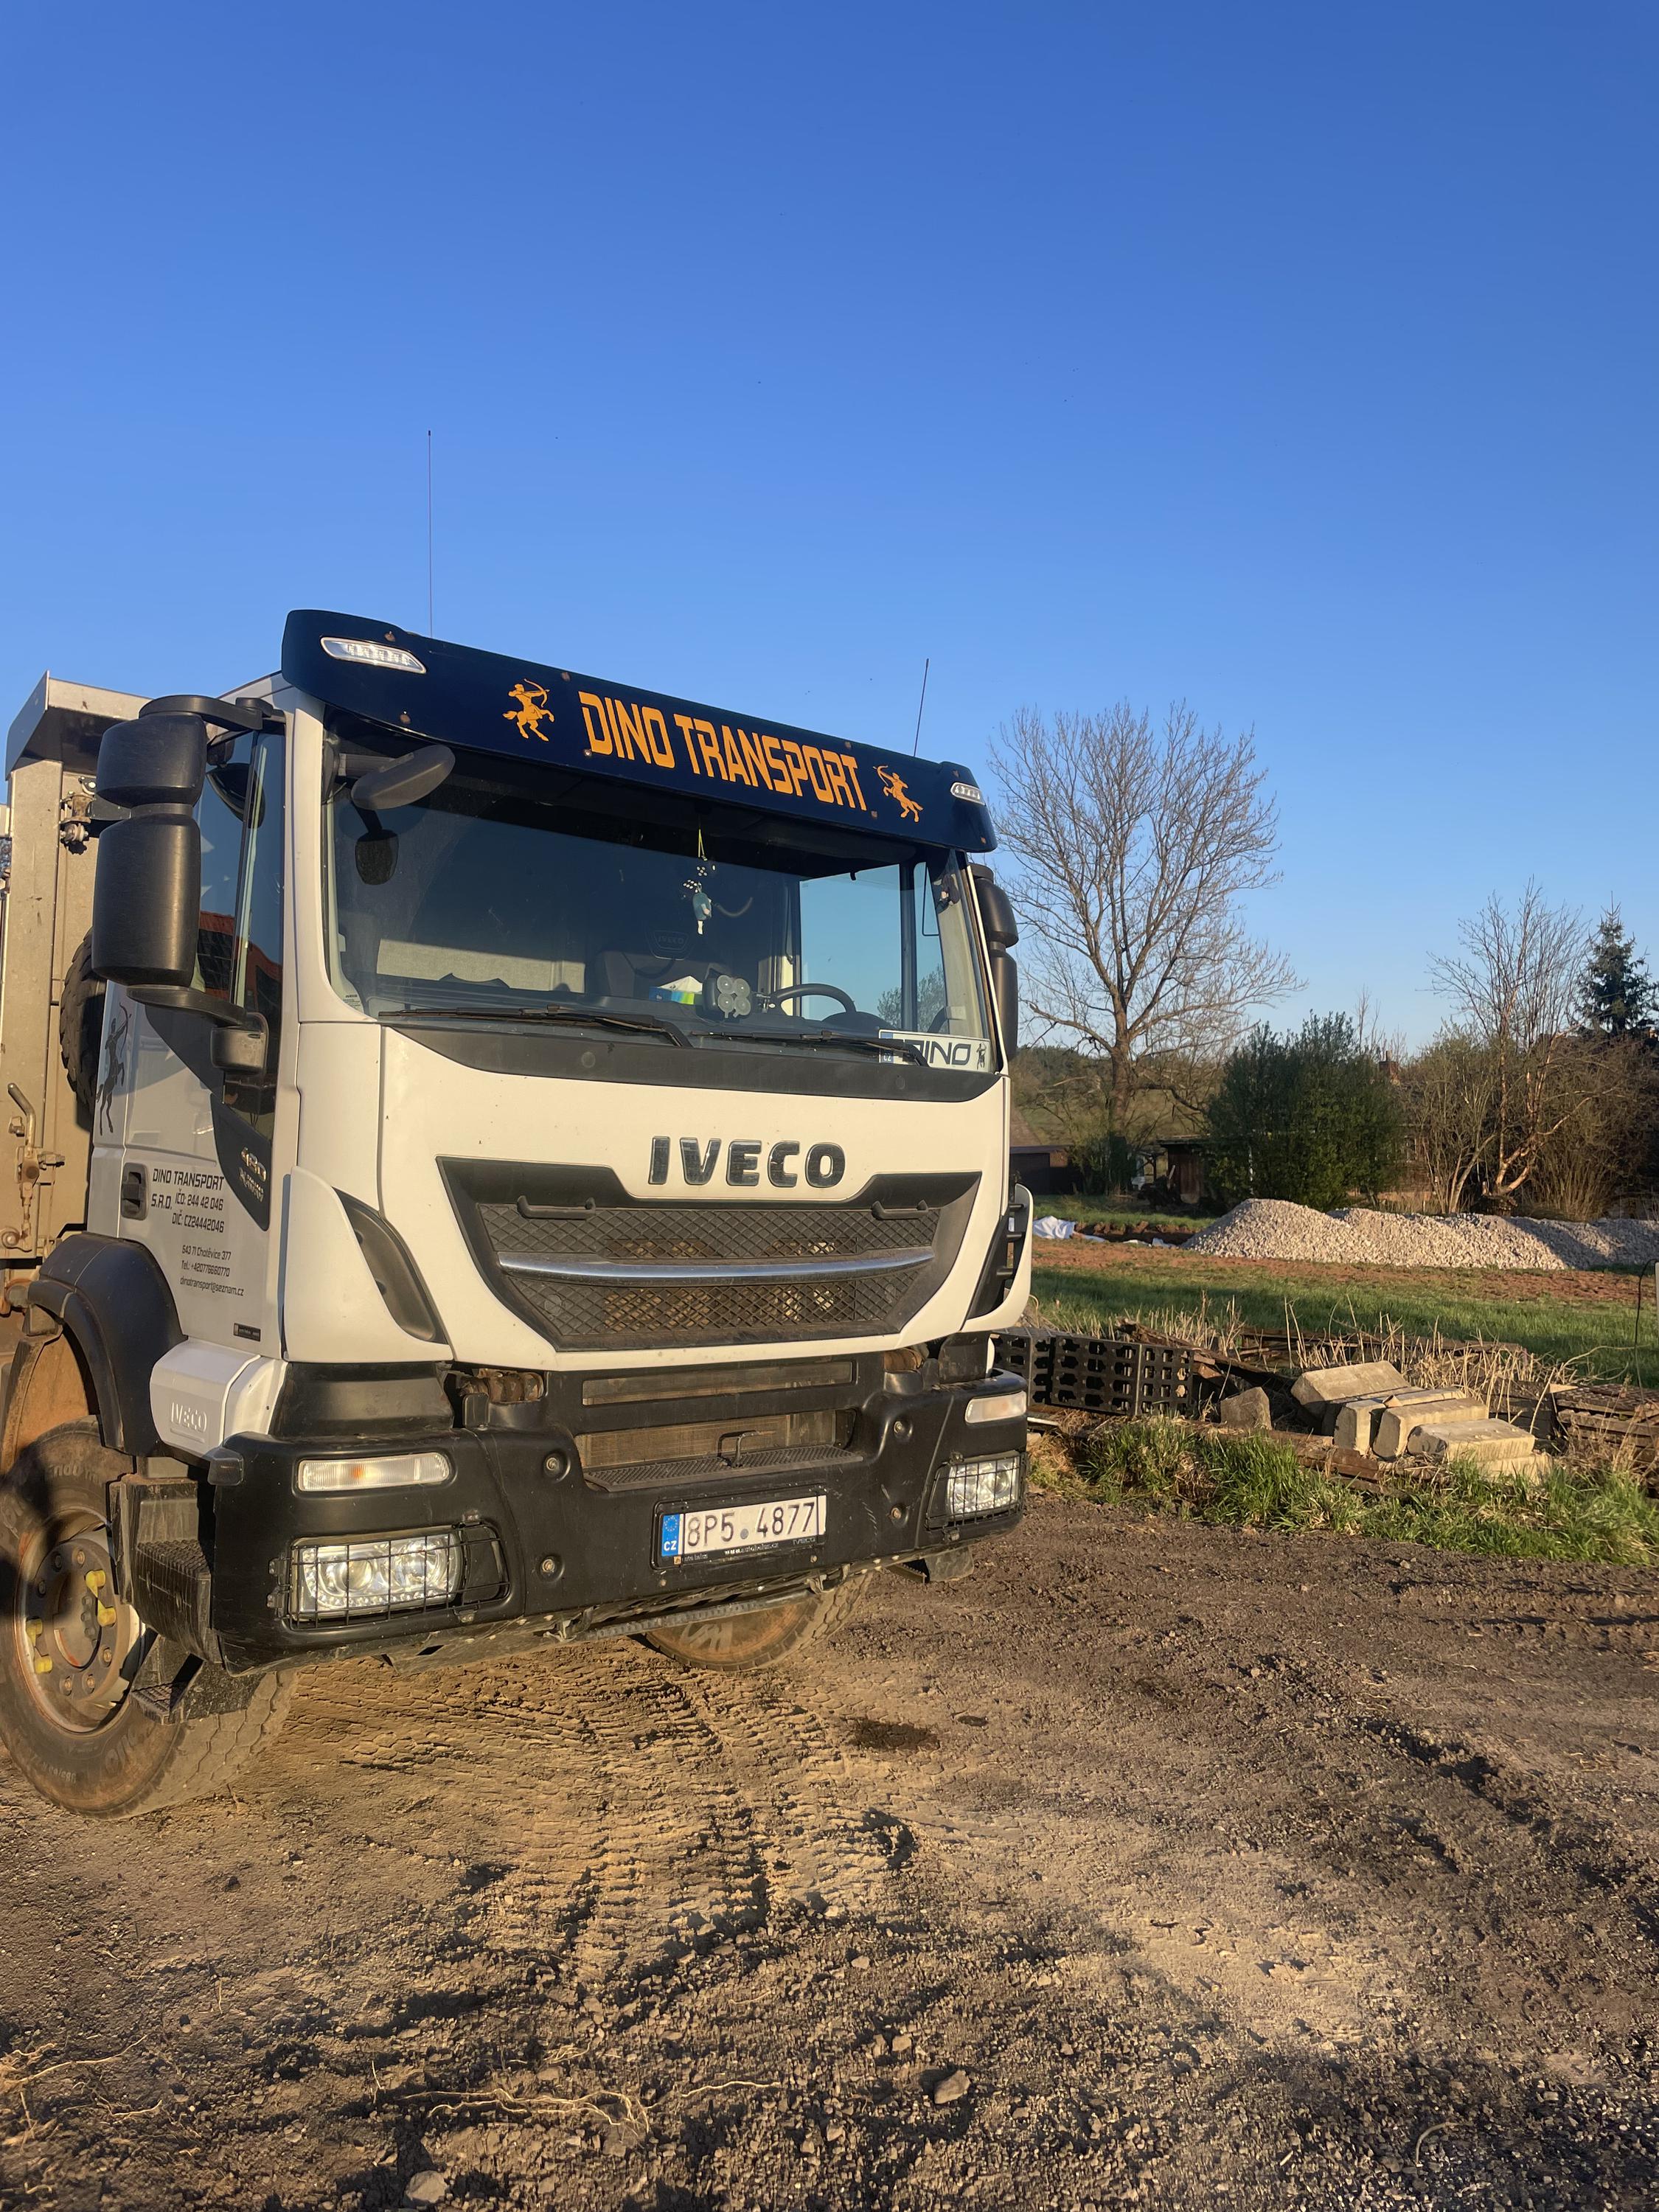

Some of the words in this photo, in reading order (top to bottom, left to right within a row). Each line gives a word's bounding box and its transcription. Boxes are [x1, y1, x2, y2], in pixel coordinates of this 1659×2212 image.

[578, 690, 676, 770] DINO
[673, 712, 868, 811] TRANSPORT
[648, 1135, 846, 1188] IVECO
[153, 1168, 172, 1183] DINO
[174, 1171, 224, 1190] TRANSPORT
[151, 1193, 173, 1210] S.R.O.
[187, 1194, 199, 1206] 244
[201, 1196, 209, 1208] 42
[210, 1197, 223, 1211] 046
[172, 1209, 183, 1225] DIČ:
[184, 1214, 225, 1233] CZ24442046
[182, 1245, 192, 1255] 543
[197, 1246, 221, 1260] Chotěvice
[222, 1251, 232, 1261] 377
[191, 1262, 230, 1277] +420776660770
[180, 1276, 244, 1296] dinotransport@seznam.cz
[171, 1402, 207, 1432] IVECO
[687, 1512, 735, 1548] 8P5
[757, 1502, 815, 1538] 4877
[664, 1540, 677, 1552] CZ
